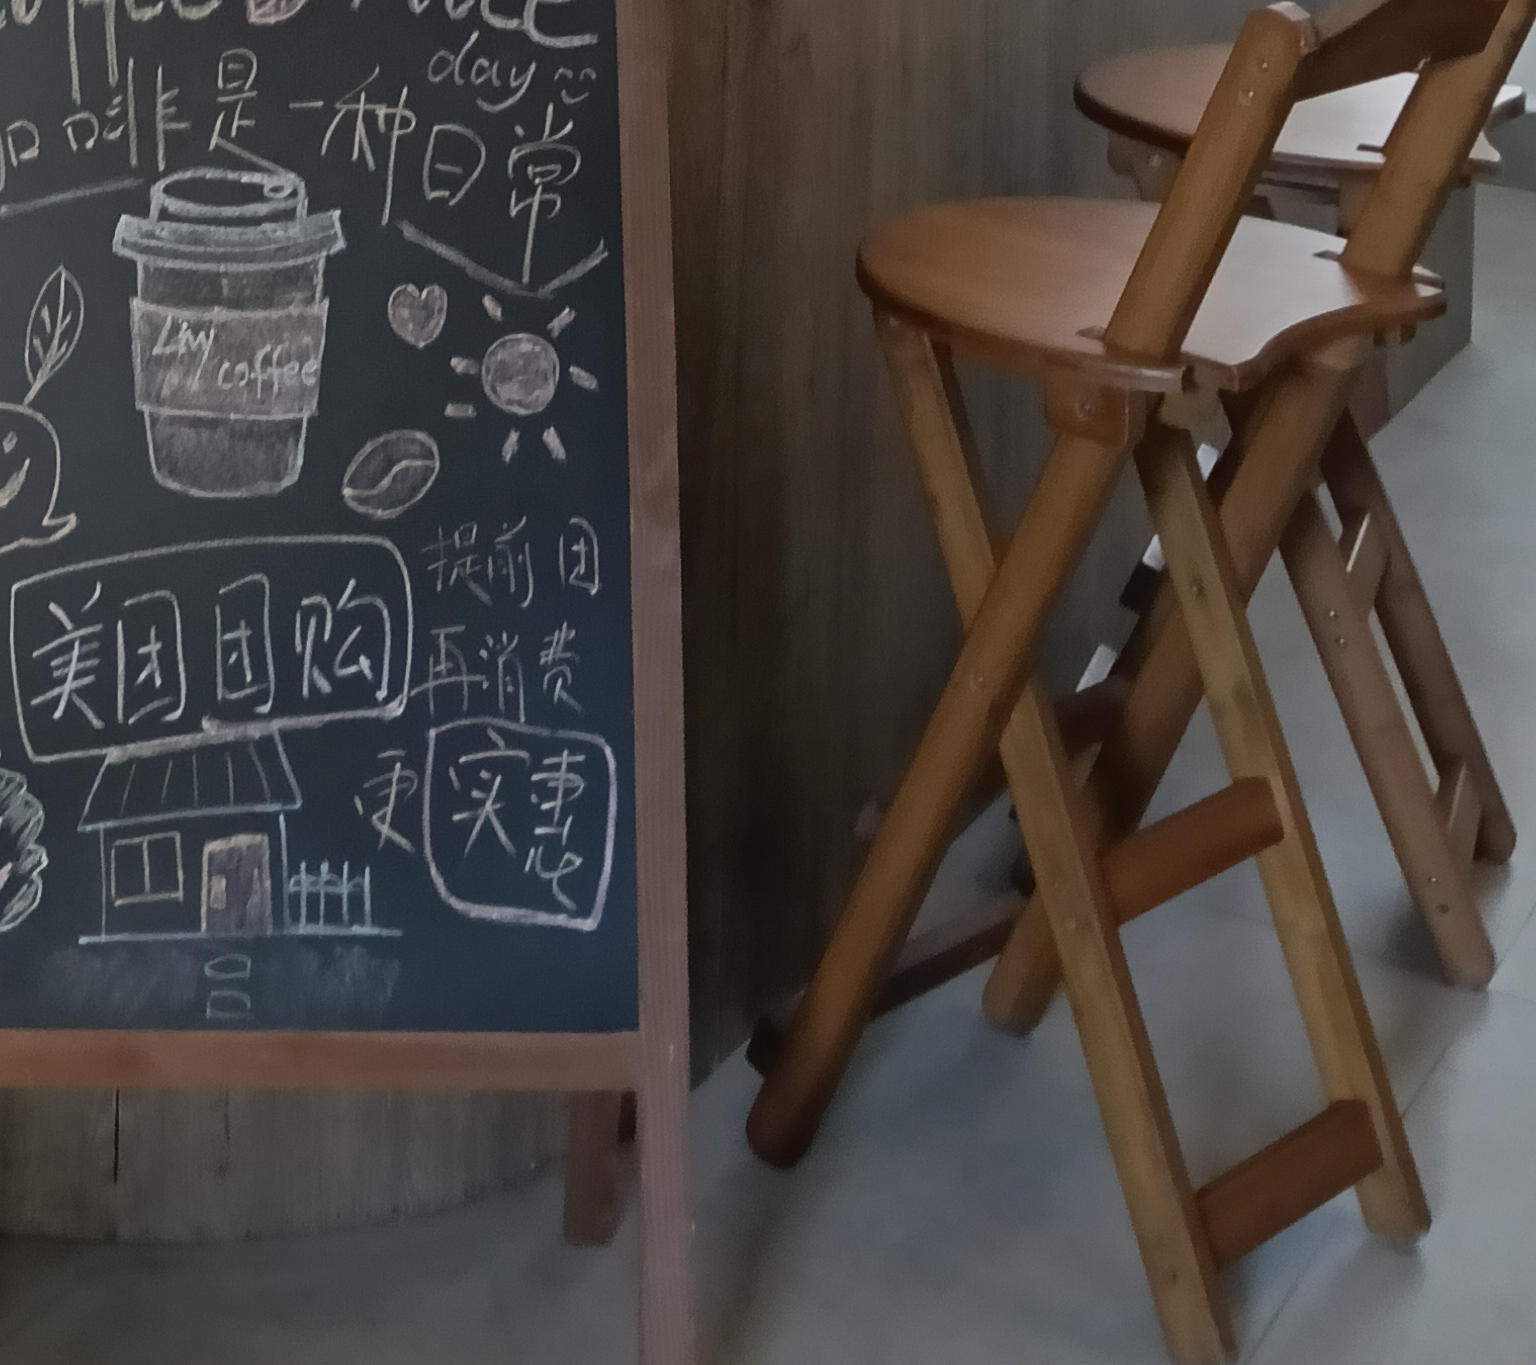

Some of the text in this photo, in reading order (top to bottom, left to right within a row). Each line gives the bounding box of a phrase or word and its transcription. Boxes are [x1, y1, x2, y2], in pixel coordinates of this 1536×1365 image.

[426, 30, 537, 112] day
[217, 342, 319, 400] coffee
[420, 515, 601, 608] 提前团
[30, 573, 392, 729] 美团团购
[409, 621, 585, 722] 再消费
